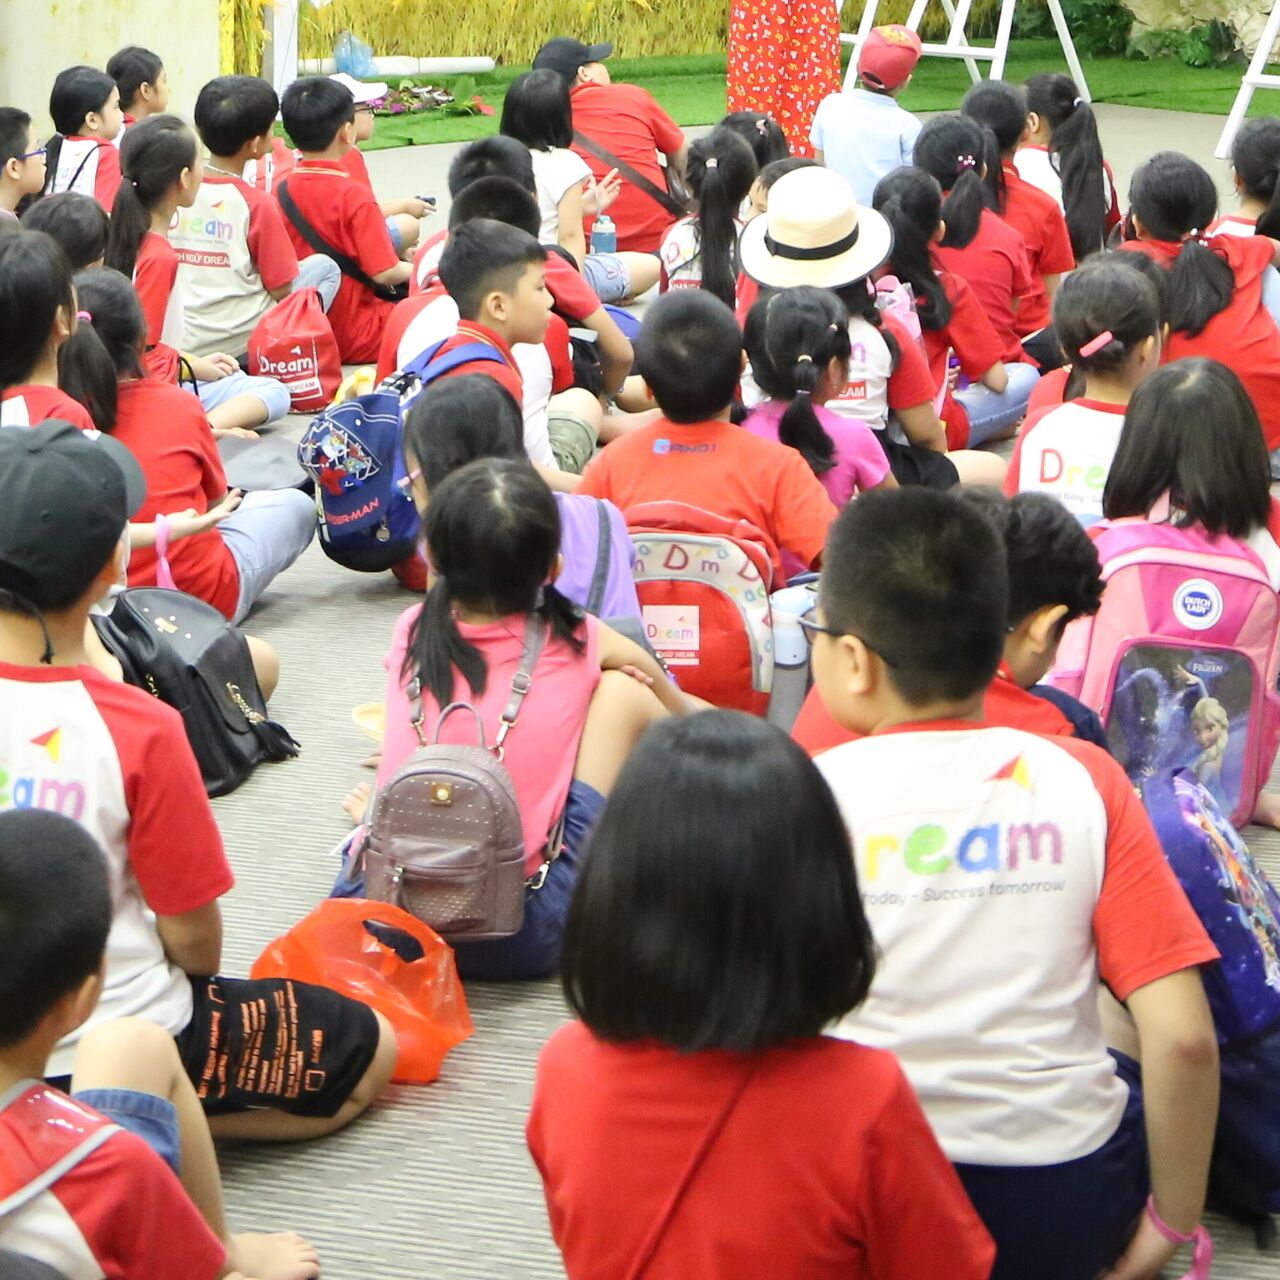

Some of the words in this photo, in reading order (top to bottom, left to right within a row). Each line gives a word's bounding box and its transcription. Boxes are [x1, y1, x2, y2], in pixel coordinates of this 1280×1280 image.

[259, 356, 313, 373] Dream
[1040, 448, 1105, 490] Dre
[1185, 596, 1211, 607] DUTCH
[647, 624, 693, 640] Dream
[864, 822, 1064, 883] ream
[923, 882, 986, 903] Success
[989, 878, 1066, 897] tomorrow
